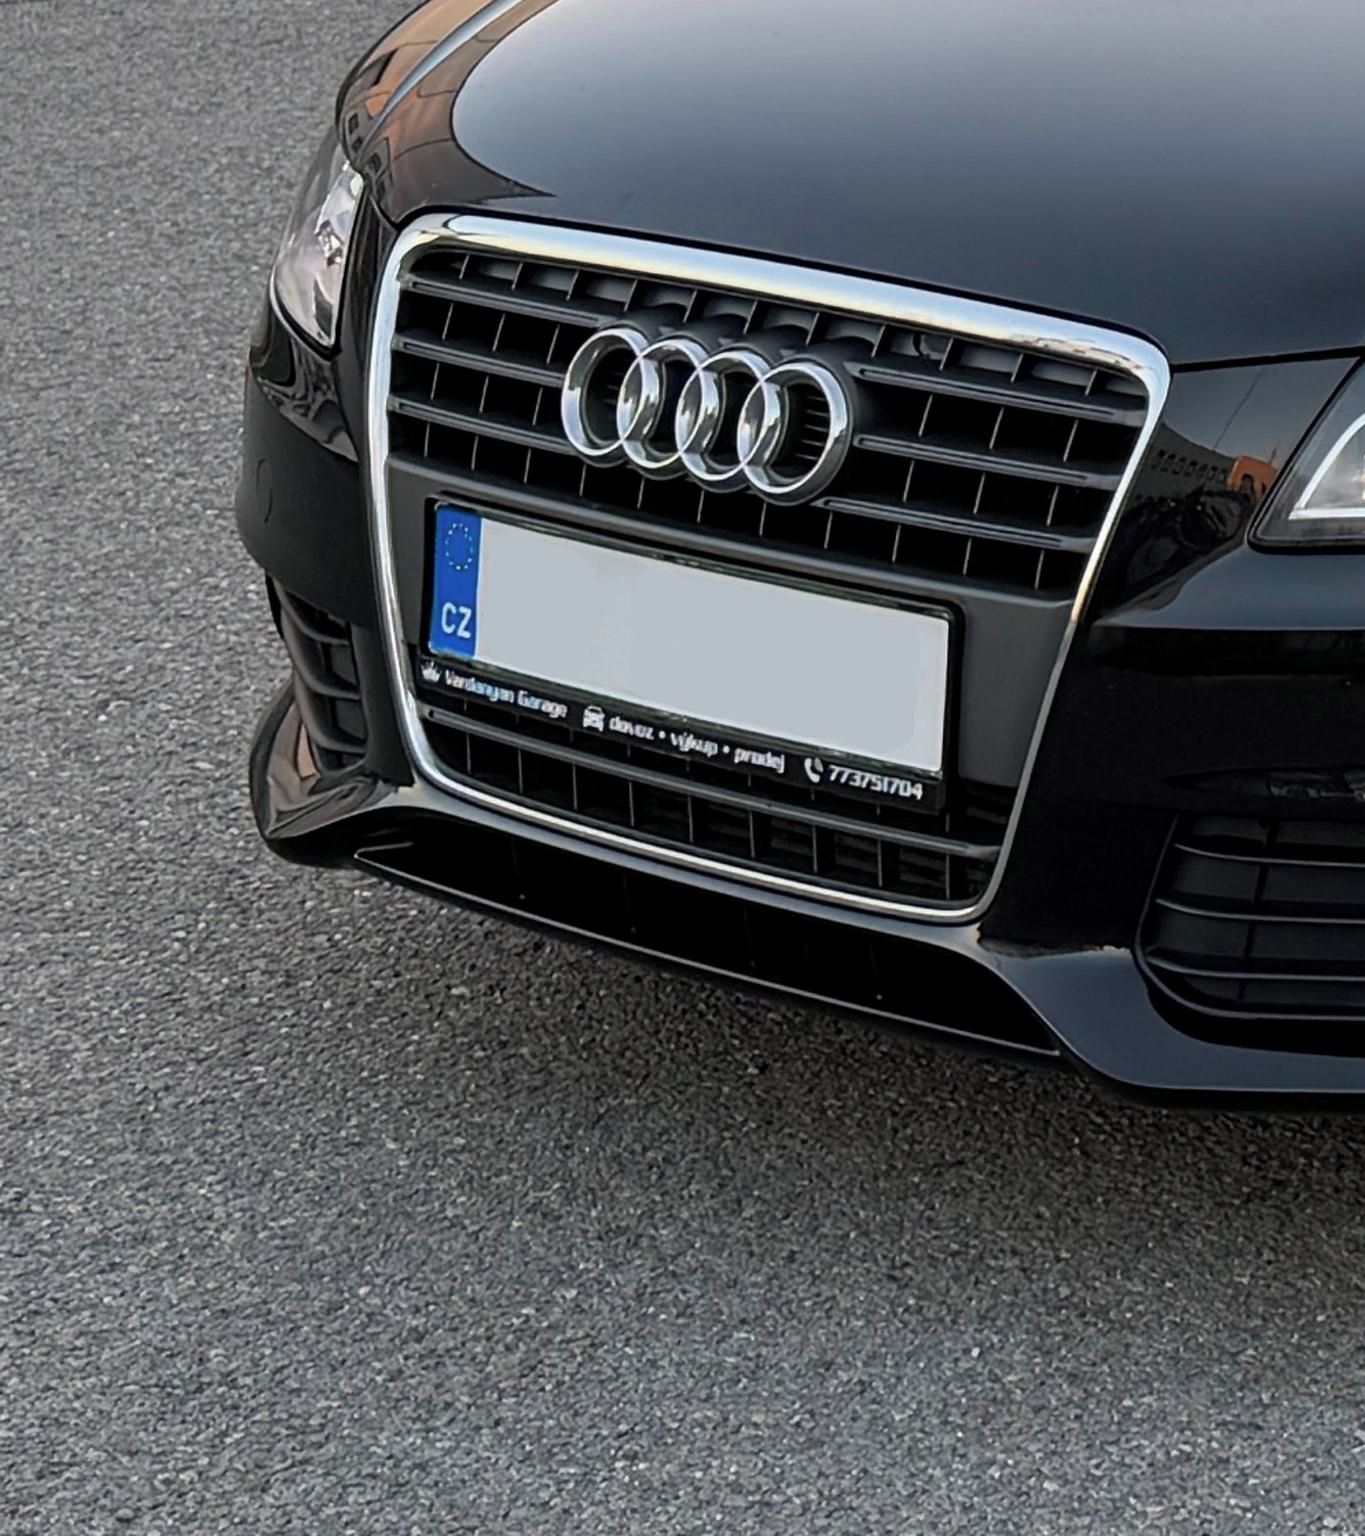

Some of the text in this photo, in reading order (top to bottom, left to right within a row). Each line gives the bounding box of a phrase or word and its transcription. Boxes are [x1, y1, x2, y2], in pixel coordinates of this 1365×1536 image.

[441, 602, 472, 638] CZ
[517, 689, 568, 718] Garage
[609, 716, 654, 740] dovoz
[734, 747, 785, 774] prodej
[828, 764, 923, 800] 773751704
